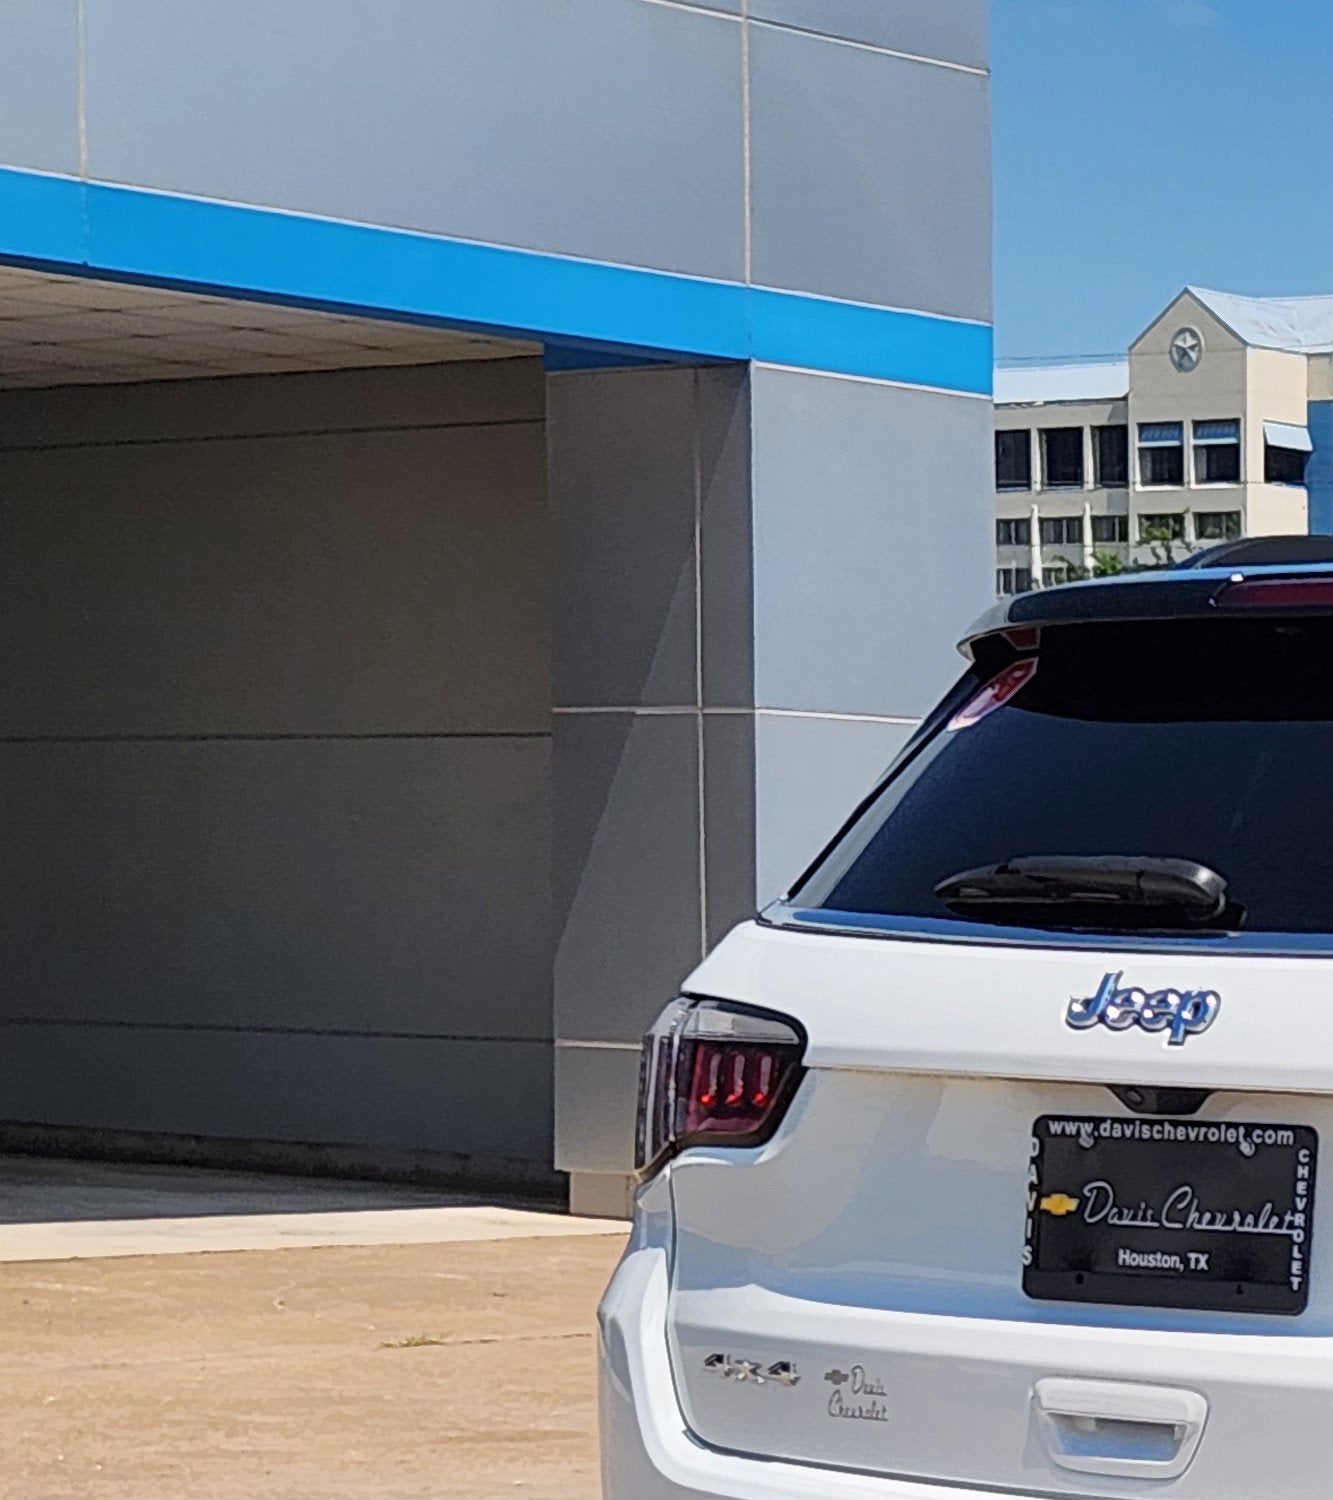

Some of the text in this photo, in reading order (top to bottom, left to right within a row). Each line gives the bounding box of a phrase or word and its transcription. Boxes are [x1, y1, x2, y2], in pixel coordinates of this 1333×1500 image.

[1066, 970, 1221, 1046] Jeep
[1048, 1119, 1295, 1146] www.davischevrolet.com
[1083, 1181, 1302, 1235] Davis Chevrolet
[1289, 1148, 1311, 1292] CHEVROLET
[1117, 1248, 1210, 1272] Houston, TX
